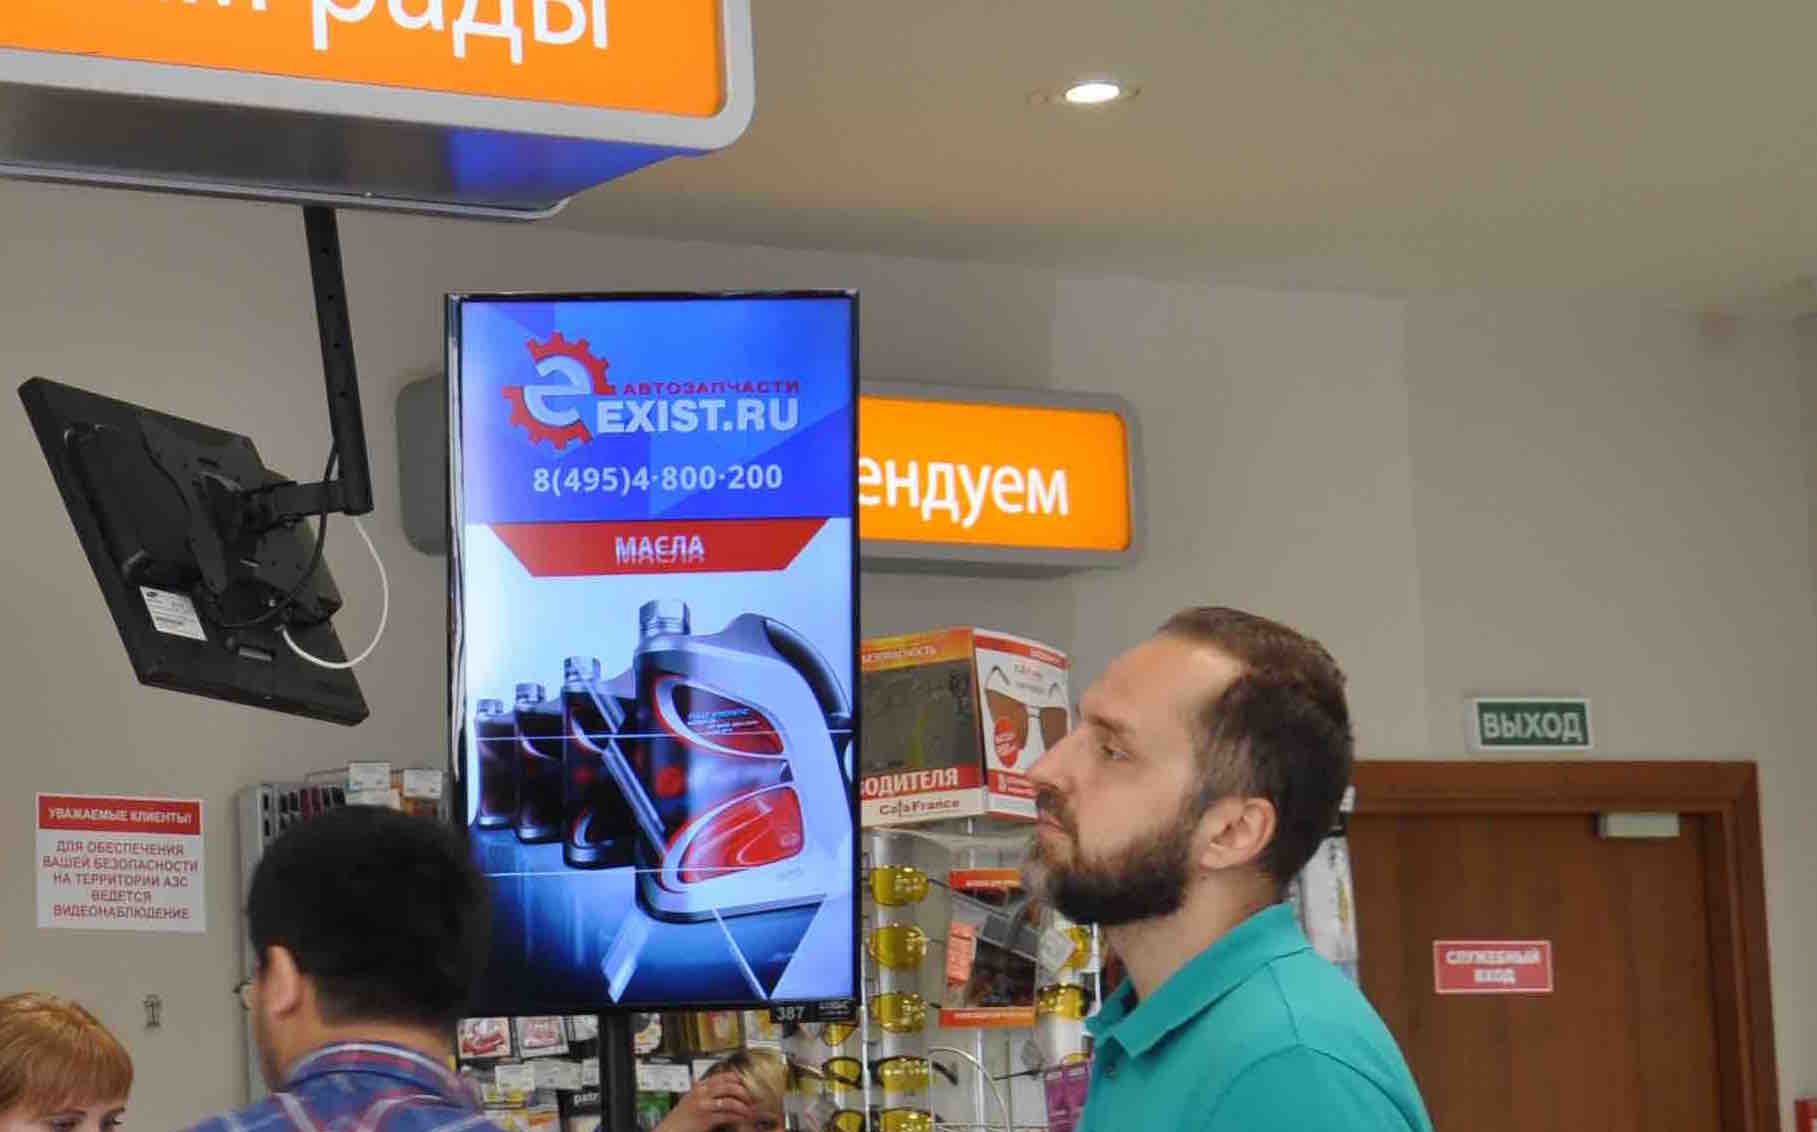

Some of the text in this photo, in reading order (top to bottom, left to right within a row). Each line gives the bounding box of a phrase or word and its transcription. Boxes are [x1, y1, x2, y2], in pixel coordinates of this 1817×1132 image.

[622, 379, 801, 398] АВТОЗАПЧАСТИ
[596, 398, 800, 435] EXIST.RU
[858, 456, 1070, 529] ендуем
[1483, 712, 1584, 743] ВЫХОД
[859, 767, 959, 798] ОДИТЕЛЯ
[47, 807, 129, 823] УВАЖАЕМЫЕ
[55, 840, 184, 856] ДЛЯ ОБЕСПЕЧЕНИЯ
[42, 855, 198, 873] ВАШЕЙ БЕЗОПАСНОСТИ
[53, 873, 189, 888] НА ТЕРРИТОРИИ АЗС
[90, 889, 152, 903] ВЕДЕТСЯ
[52, 904, 190, 920] ВИДЕОНАБЛЮДЕНИЕ
